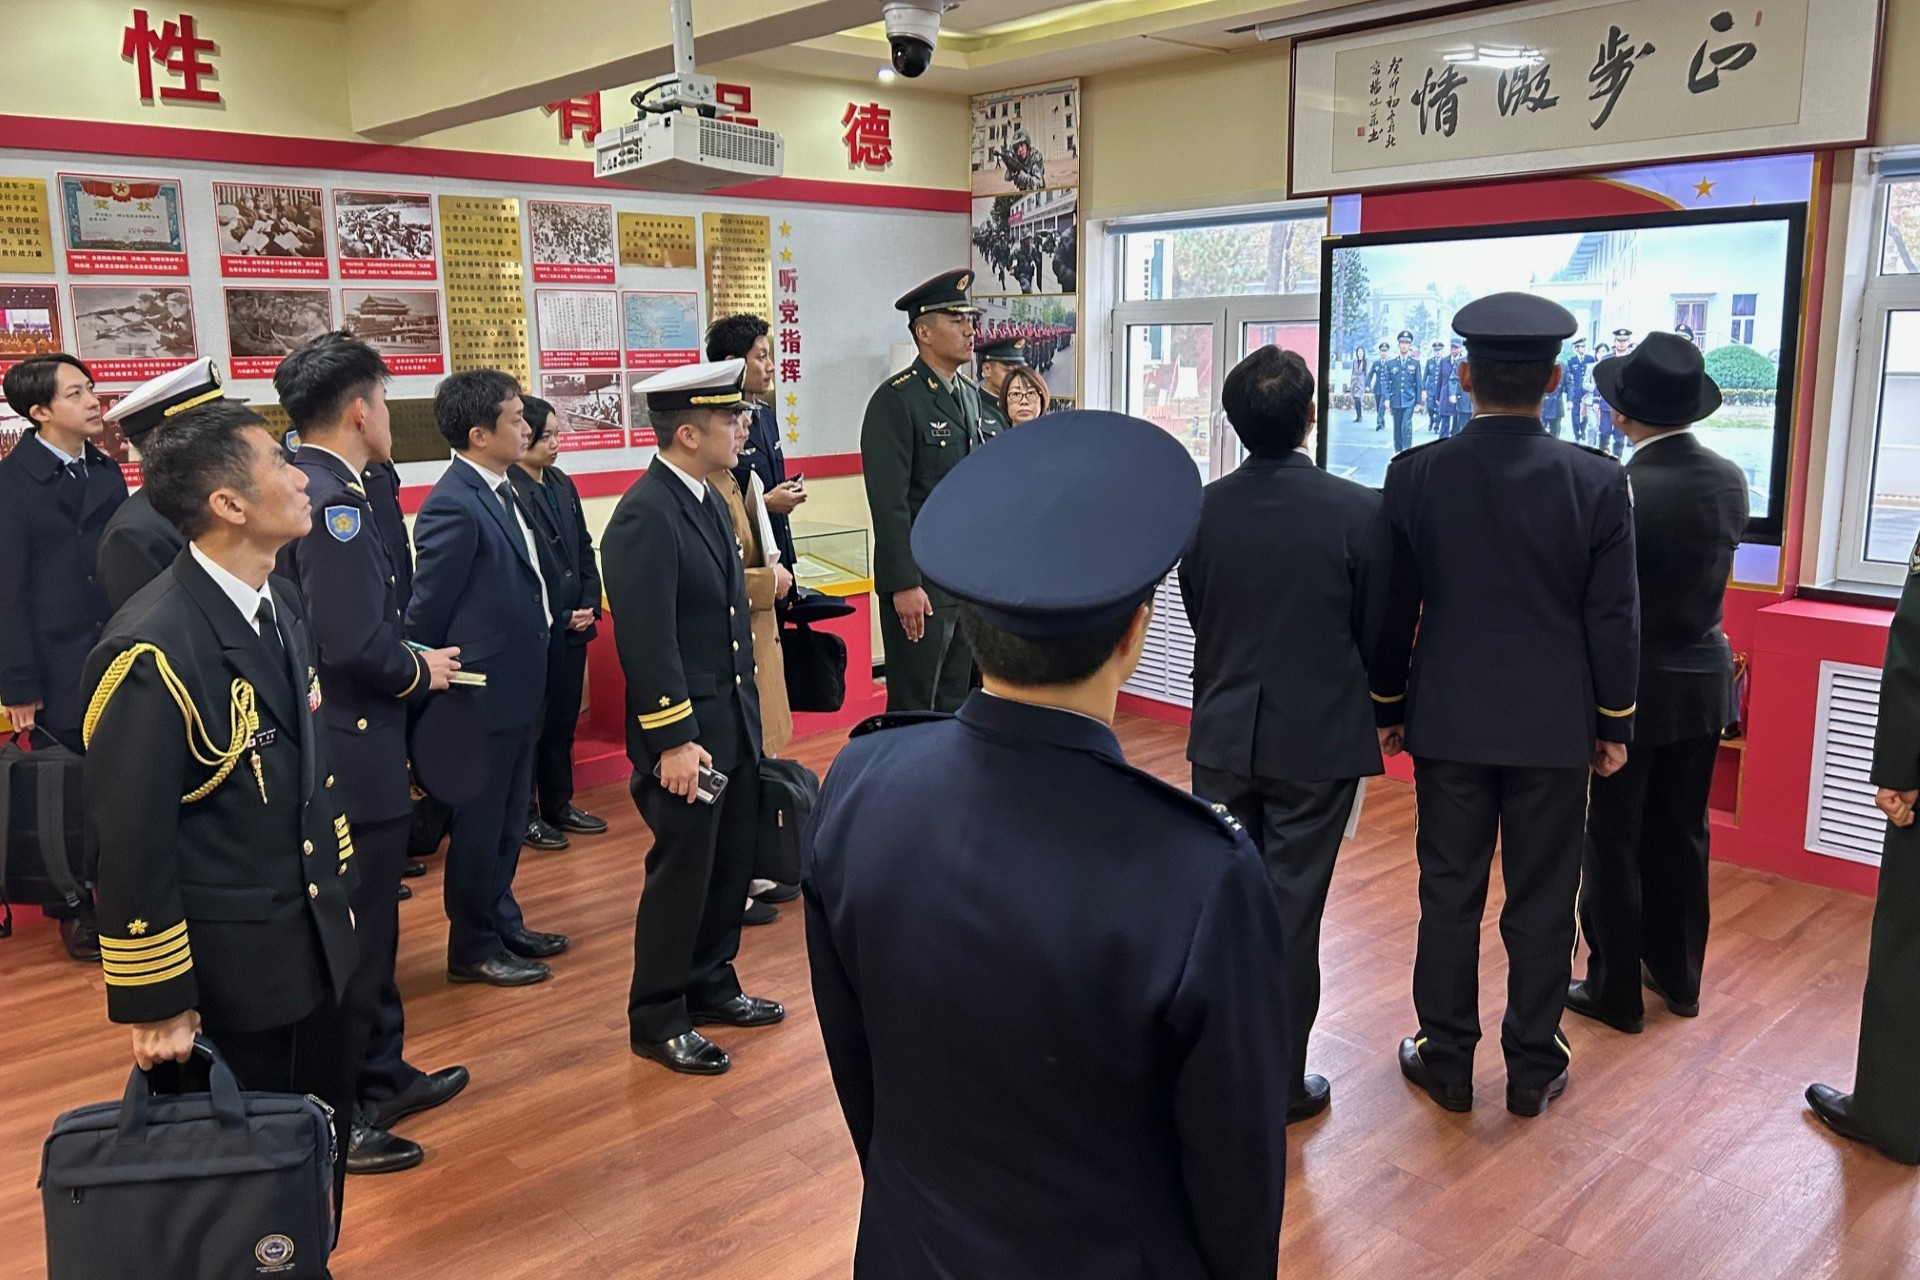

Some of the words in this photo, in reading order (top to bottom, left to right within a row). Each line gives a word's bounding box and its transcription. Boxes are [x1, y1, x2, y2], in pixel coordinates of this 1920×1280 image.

[121, 8, 222, 106] 性
[778, 268, 802, 384] 听党指挥
